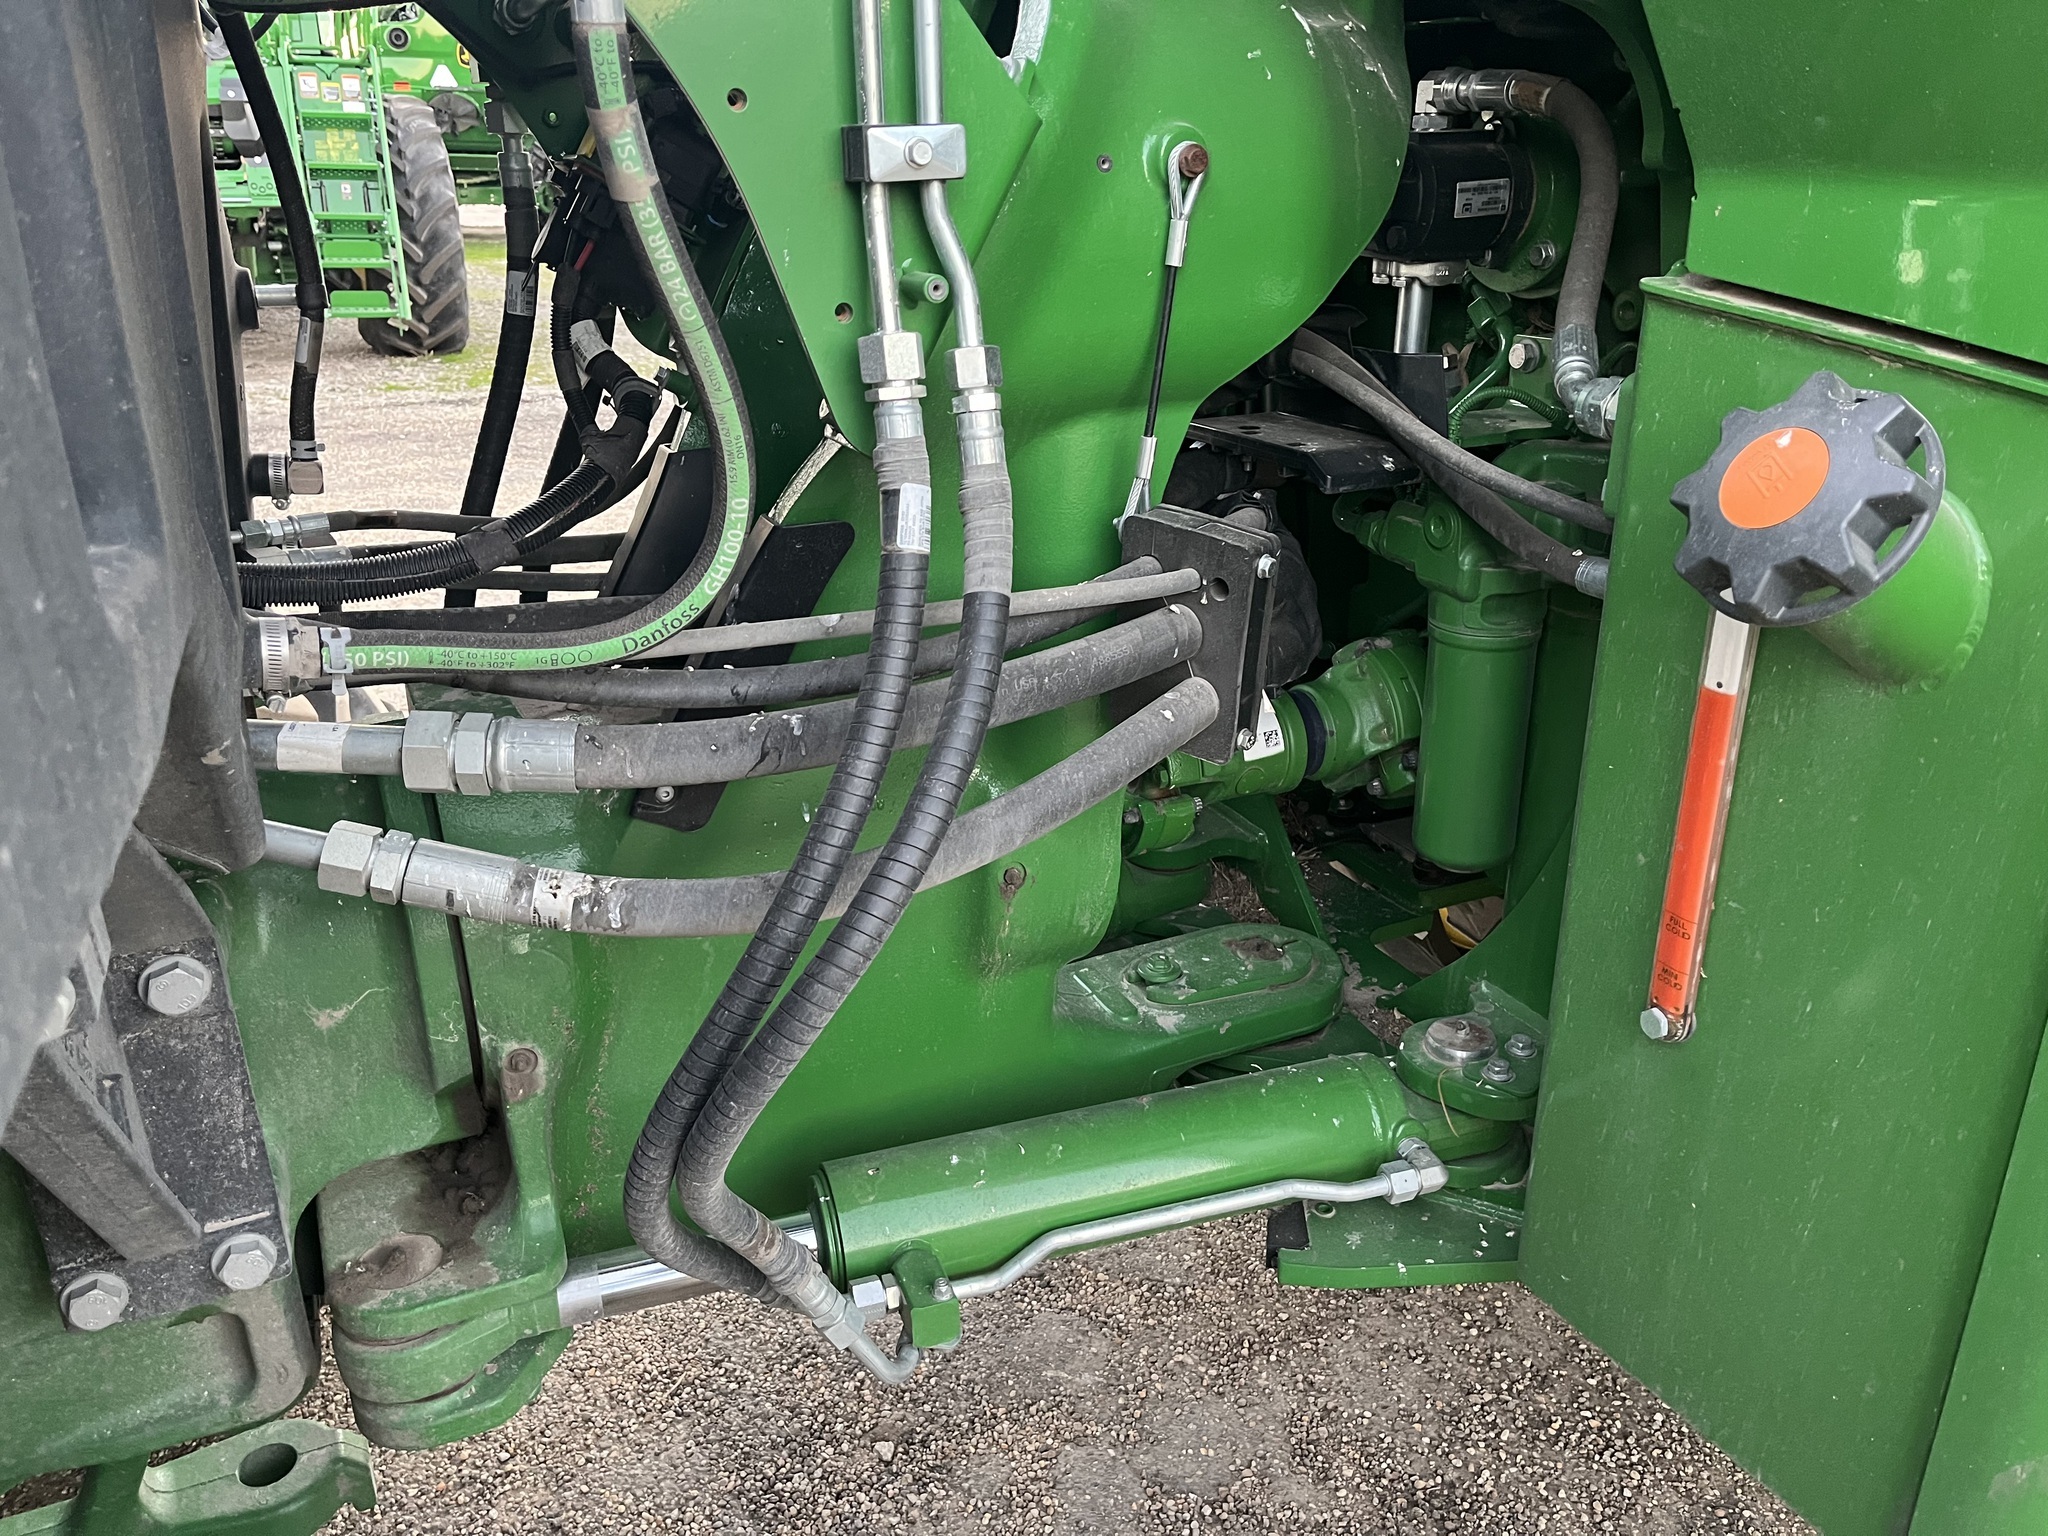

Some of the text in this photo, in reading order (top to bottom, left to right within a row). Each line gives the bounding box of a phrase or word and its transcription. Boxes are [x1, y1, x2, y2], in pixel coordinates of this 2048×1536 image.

[648, 230, 676, 275] BAR
[667, 278, 689, 302] 24
[705, 366, 723, 393] ASTM
[733, 434, 745, 460] DN16
[704, 497, 749, 596] GH100-10
[621, 602, 700, 654] Danfoss
[372, 650, 410, 668] PSI)
[467, 651, 478, 660] to
[1665, 923, 1691, 940] COLD
[1669, 915, 1688, 931] FULL
[1657, 973, 1682, 991] COLD
[1661, 966, 1678, 981] MIN
